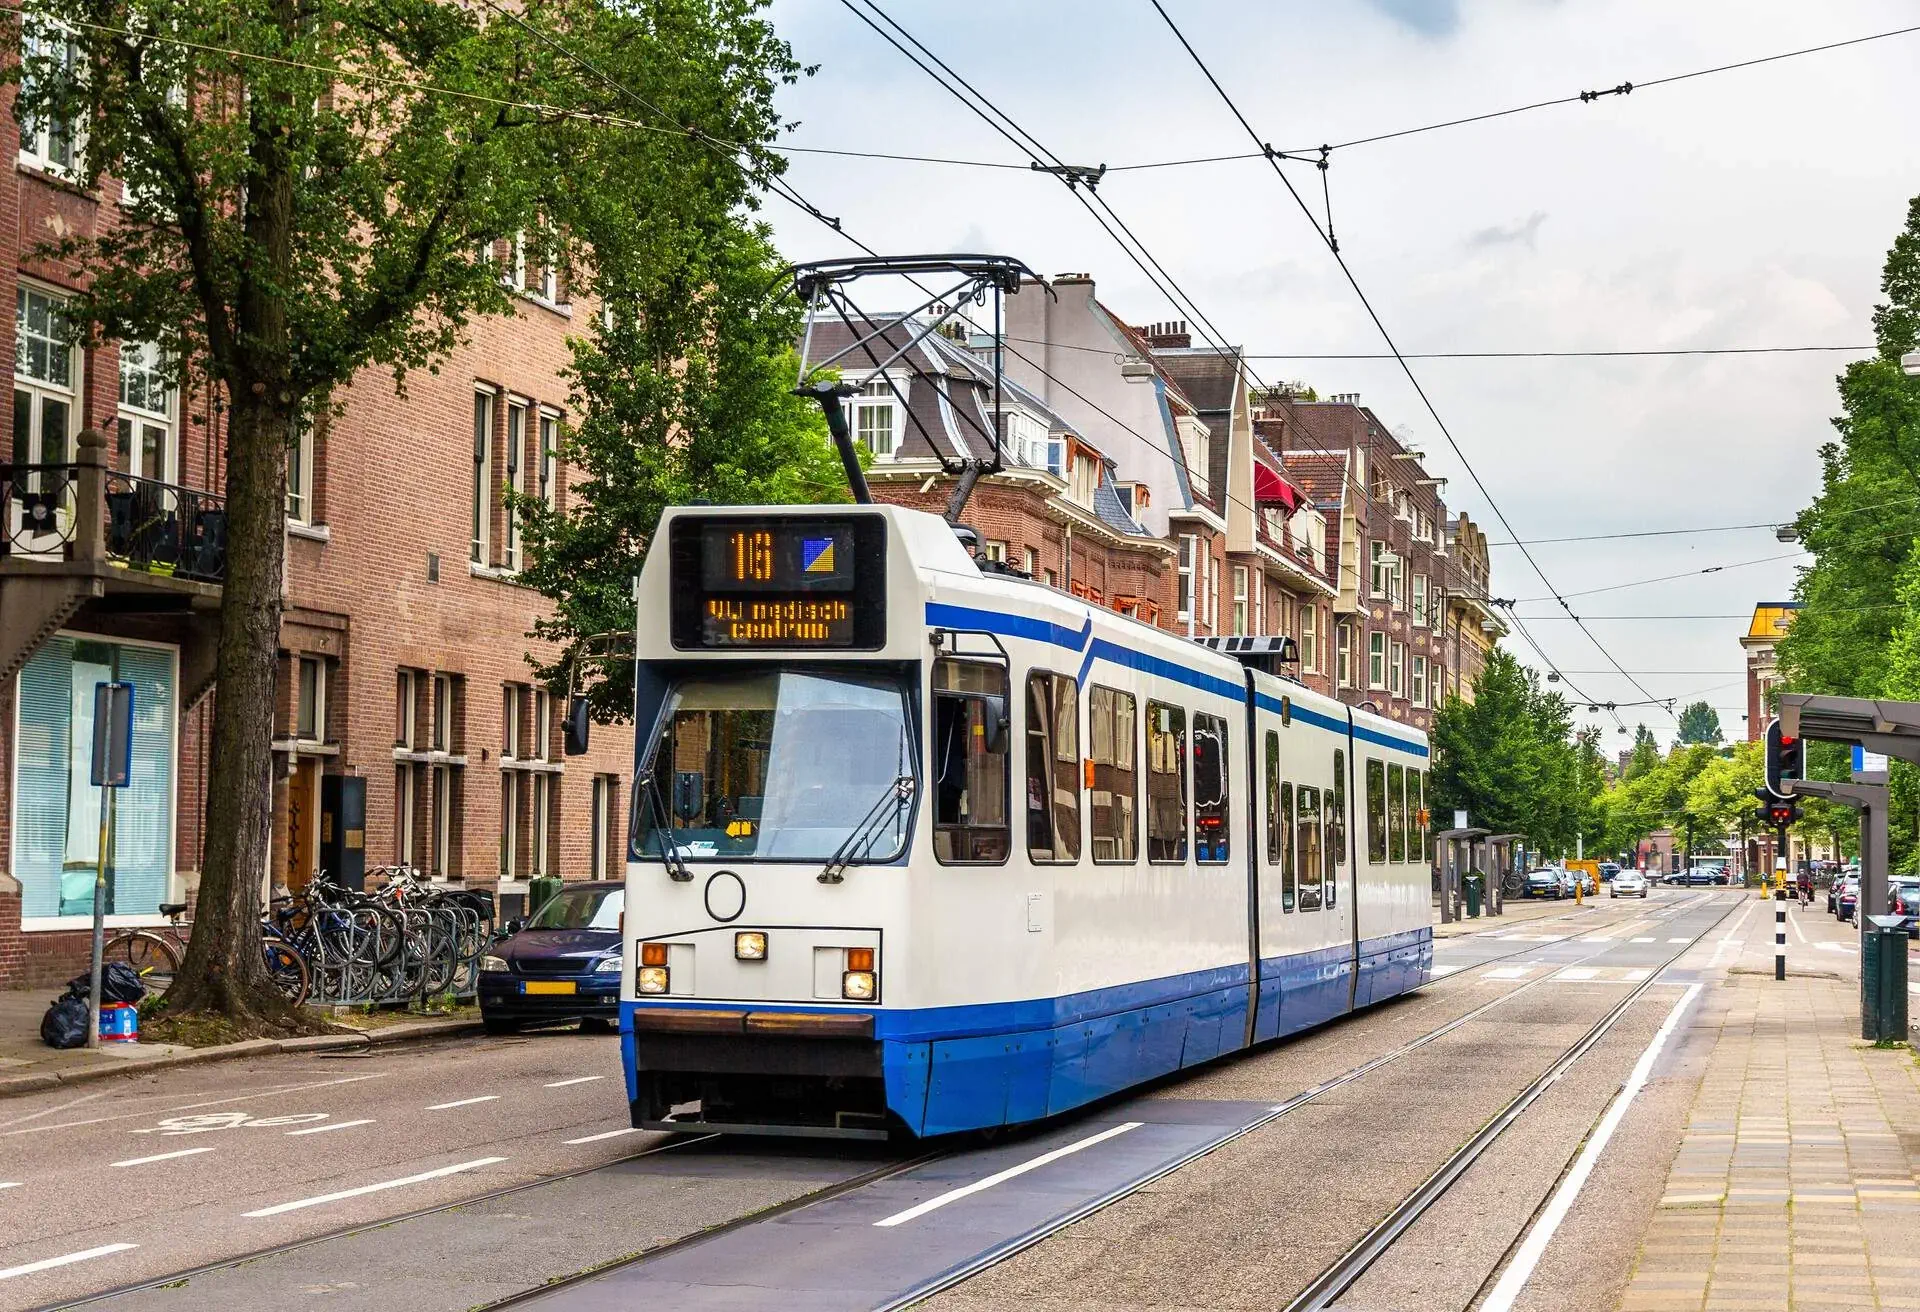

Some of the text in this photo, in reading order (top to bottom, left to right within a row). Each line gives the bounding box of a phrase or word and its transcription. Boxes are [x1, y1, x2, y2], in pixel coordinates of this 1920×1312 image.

[733, 532, 774, 580] 16
[752, 600, 847, 620] medisch
[731, 620, 829, 639] centrum
